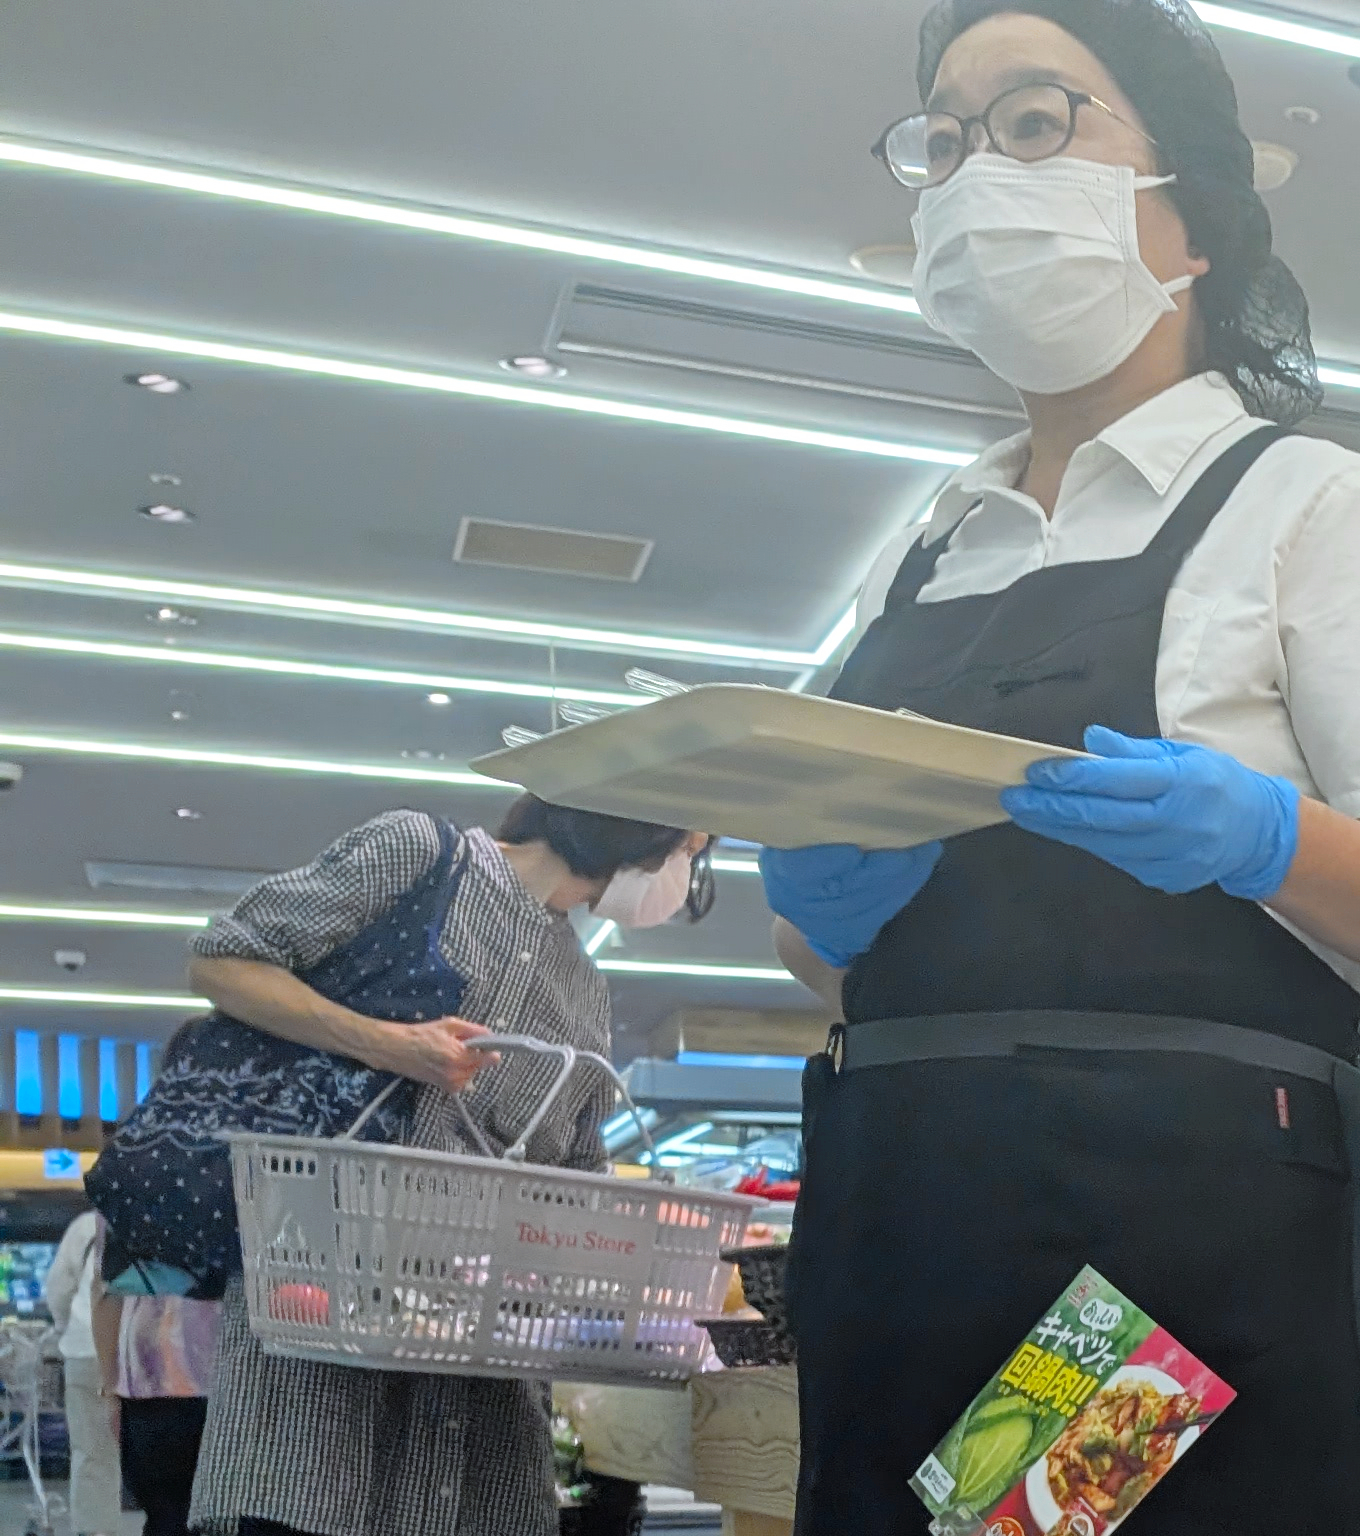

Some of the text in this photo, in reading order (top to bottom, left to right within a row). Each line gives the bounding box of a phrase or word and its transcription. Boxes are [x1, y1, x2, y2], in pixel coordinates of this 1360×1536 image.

[517, 1220, 637, 1256] Tokyu Store
[1036, 1310, 1118, 1376] キャベツで
